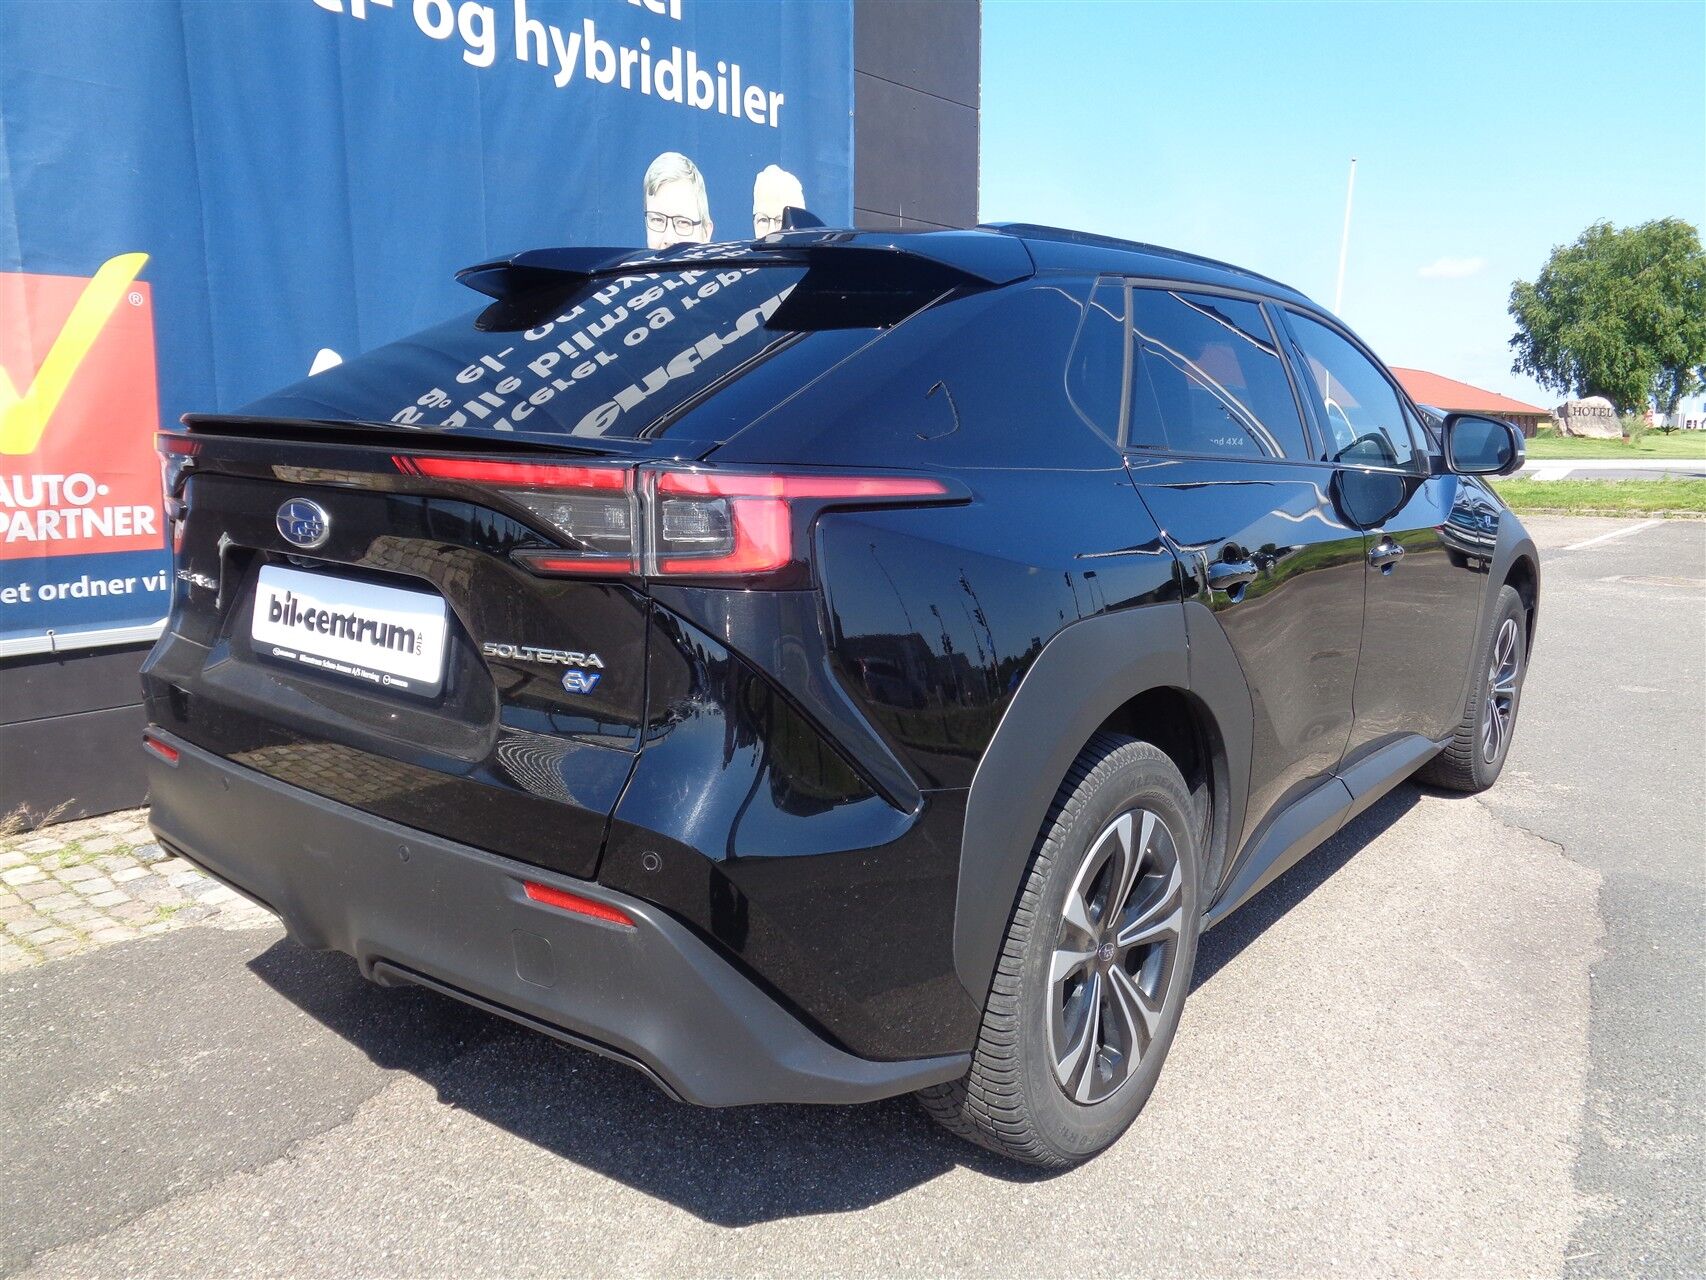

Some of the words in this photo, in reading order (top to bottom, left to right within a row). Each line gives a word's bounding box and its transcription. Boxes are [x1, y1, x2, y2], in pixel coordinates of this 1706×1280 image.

[412, 0, 496, 67] og
[514, 0, 785, 128] hybridbiler
[1572, 406, 1613, 418] HOTEL
[38, 575, 136, 601] ordner
[141, 570, 167, 592] vi
[483, 642, 605, 669] SOLTERRA
[561, 669, 601, 695] EV
